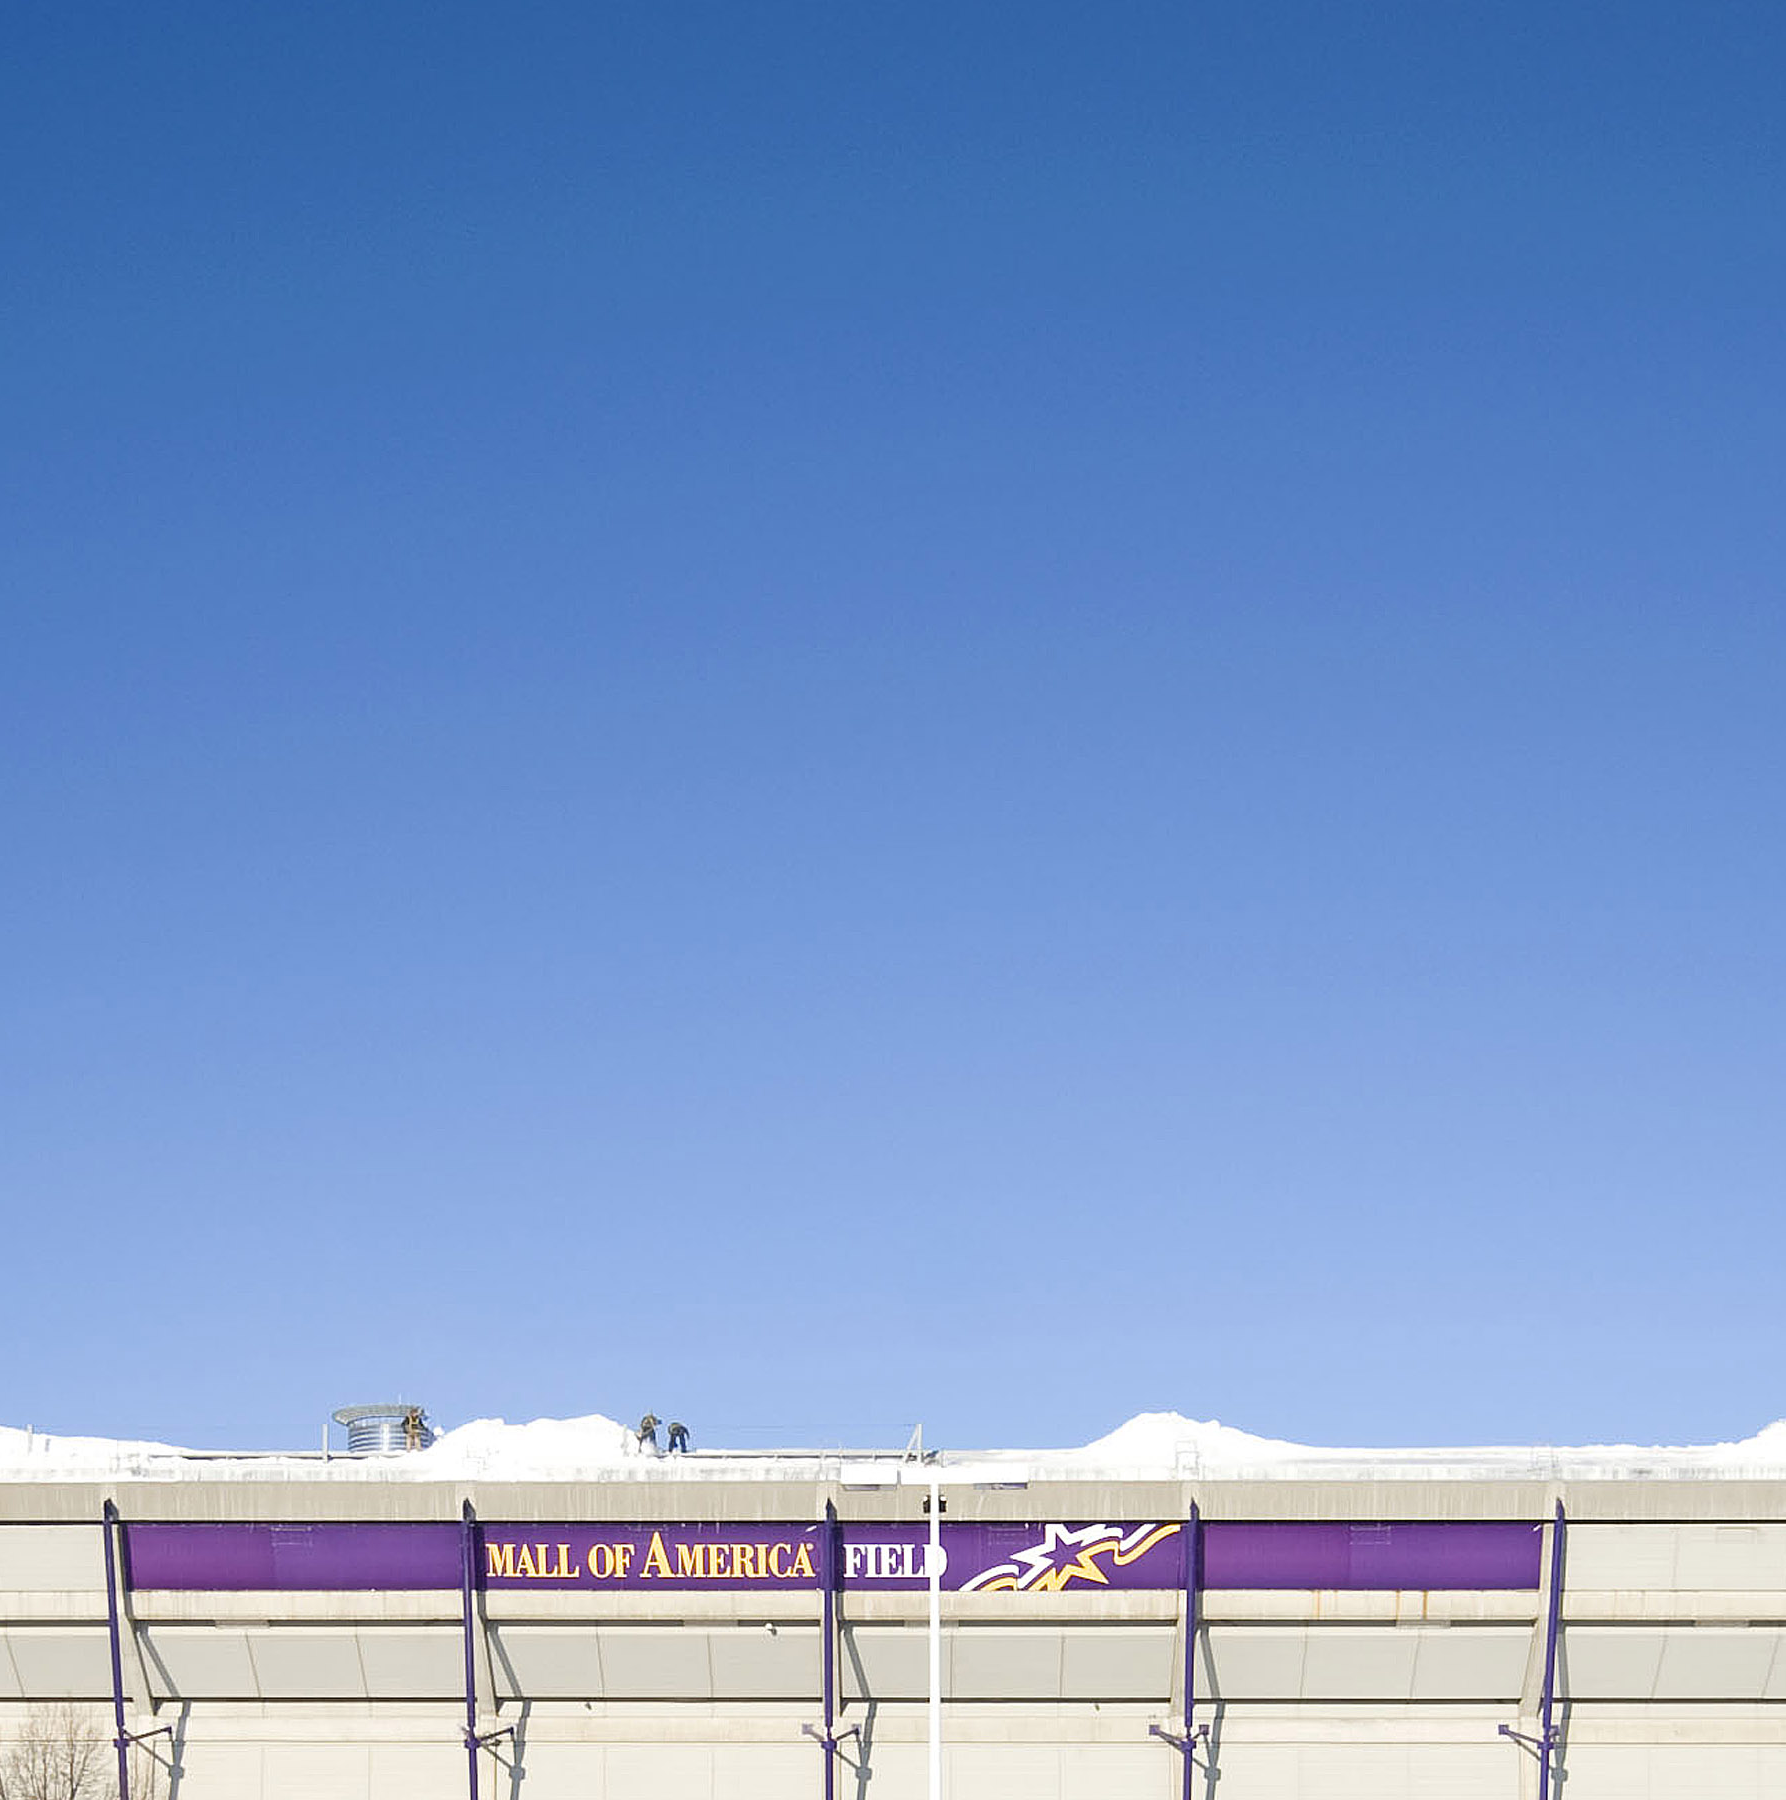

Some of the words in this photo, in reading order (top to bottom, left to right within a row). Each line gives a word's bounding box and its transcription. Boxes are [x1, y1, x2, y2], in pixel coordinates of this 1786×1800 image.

[485, 1543, 580, 1578] MALL
[587, 1543, 635, 1579] OF
[639, 1531, 816, 1579] AMERICA
[843, 1543, 948, 1578] FIELD
